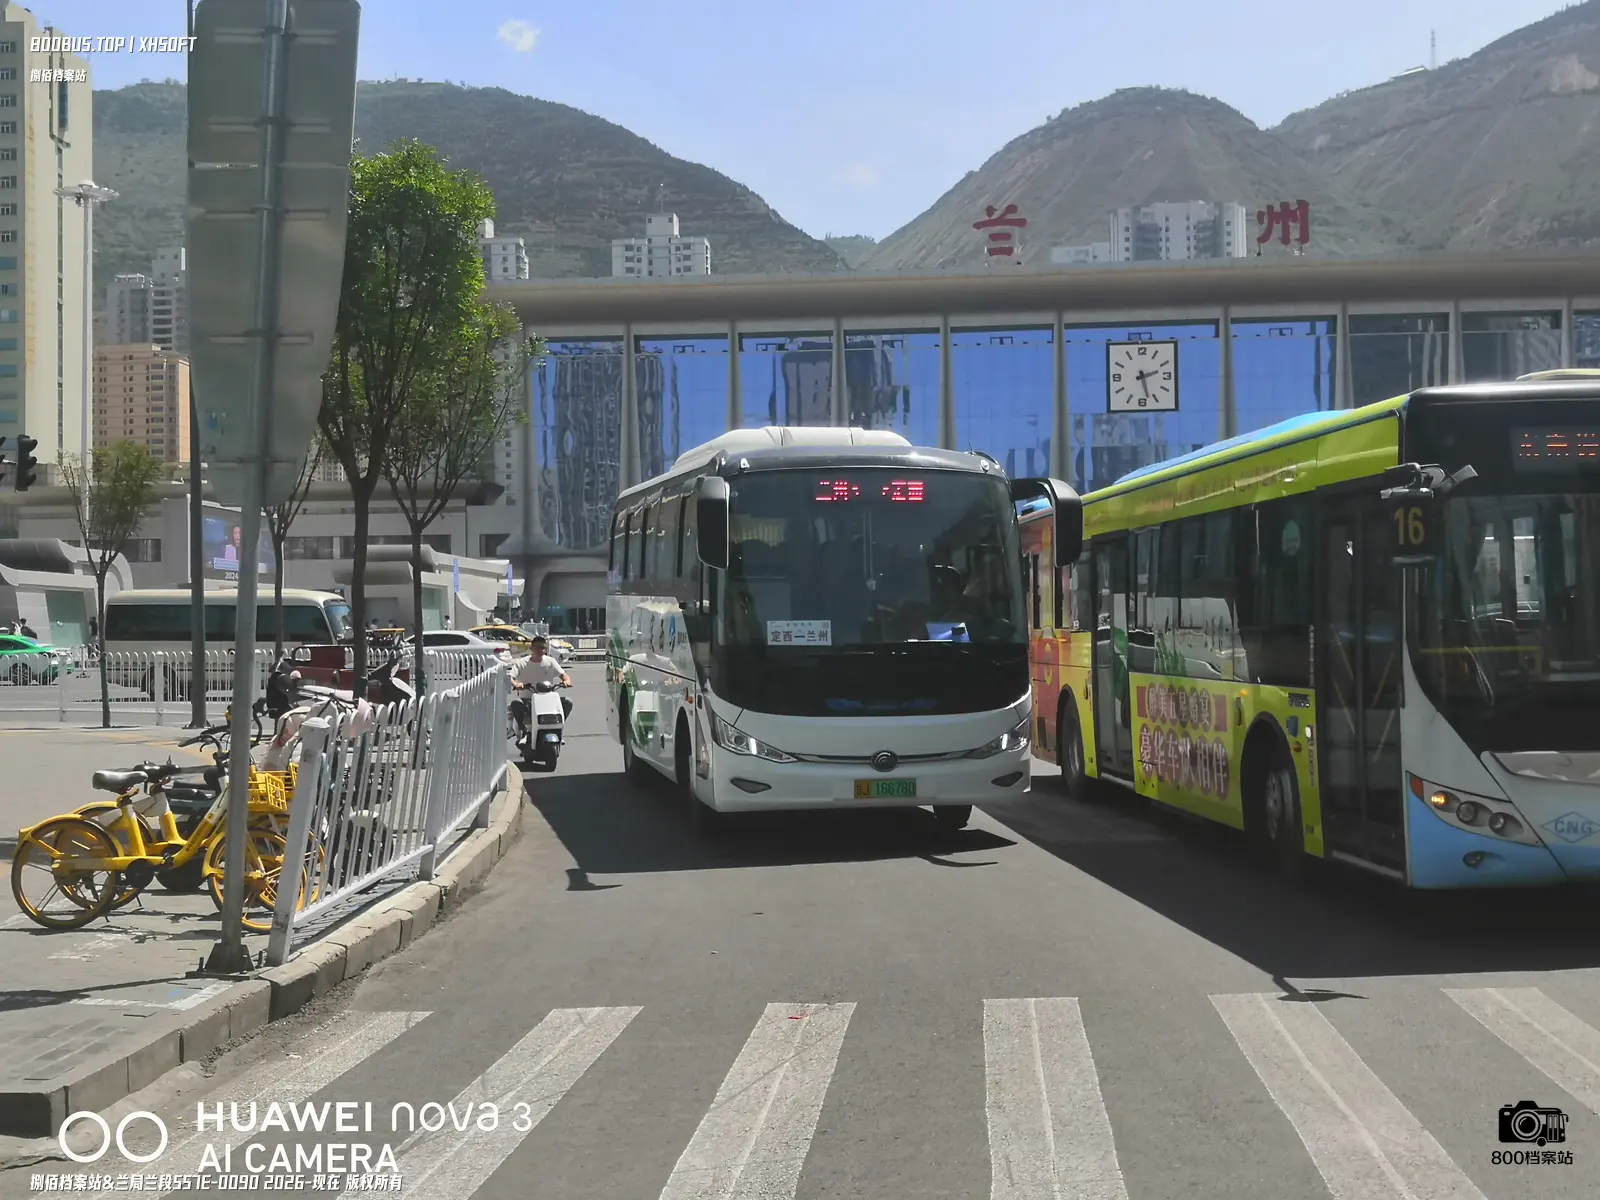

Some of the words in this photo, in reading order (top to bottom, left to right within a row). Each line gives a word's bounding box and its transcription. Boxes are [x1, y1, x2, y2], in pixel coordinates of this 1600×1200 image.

[1137, 347, 1147, 356] 12
[1162, 371, 1172, 381] 3
[1137, 398, 1147, 407] 6
[1393, 506, 1425, 546] 16
[1140, 727, 1228, 796] 豪华车队相伴
[1553, 819, 1595, 835] CNG
